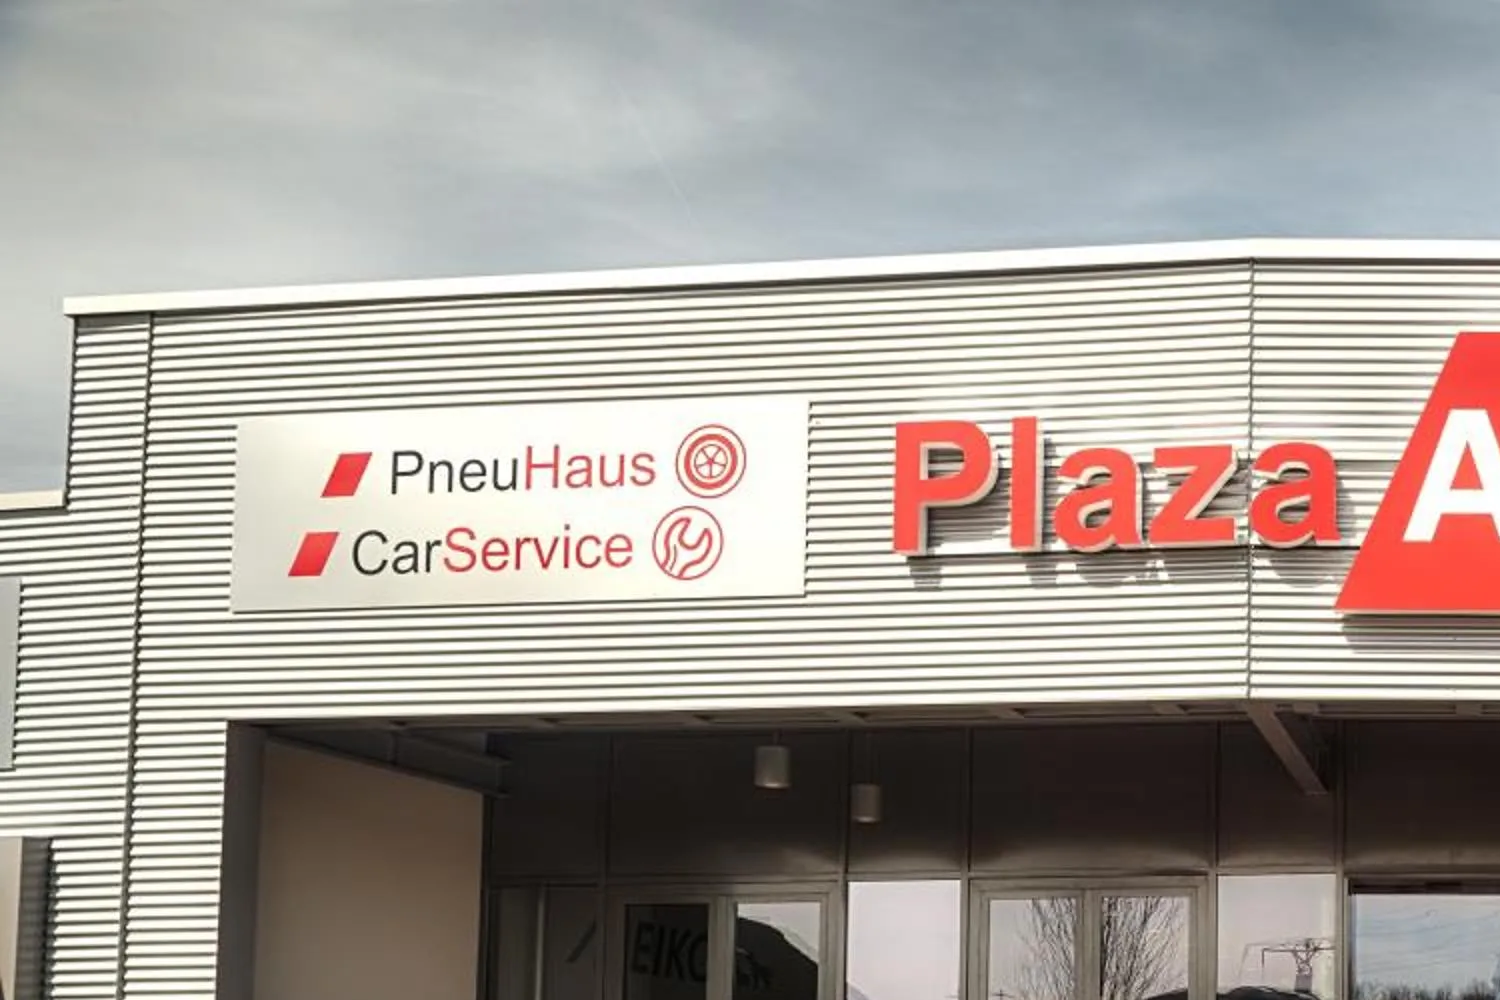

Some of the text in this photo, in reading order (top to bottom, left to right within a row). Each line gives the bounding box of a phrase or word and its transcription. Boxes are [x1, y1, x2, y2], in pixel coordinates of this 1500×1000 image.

[390, 444, 656, 495] PneuHaus
[892, 416, 1342, 557] Plaza
[352, 523, 633, 576] CarService
